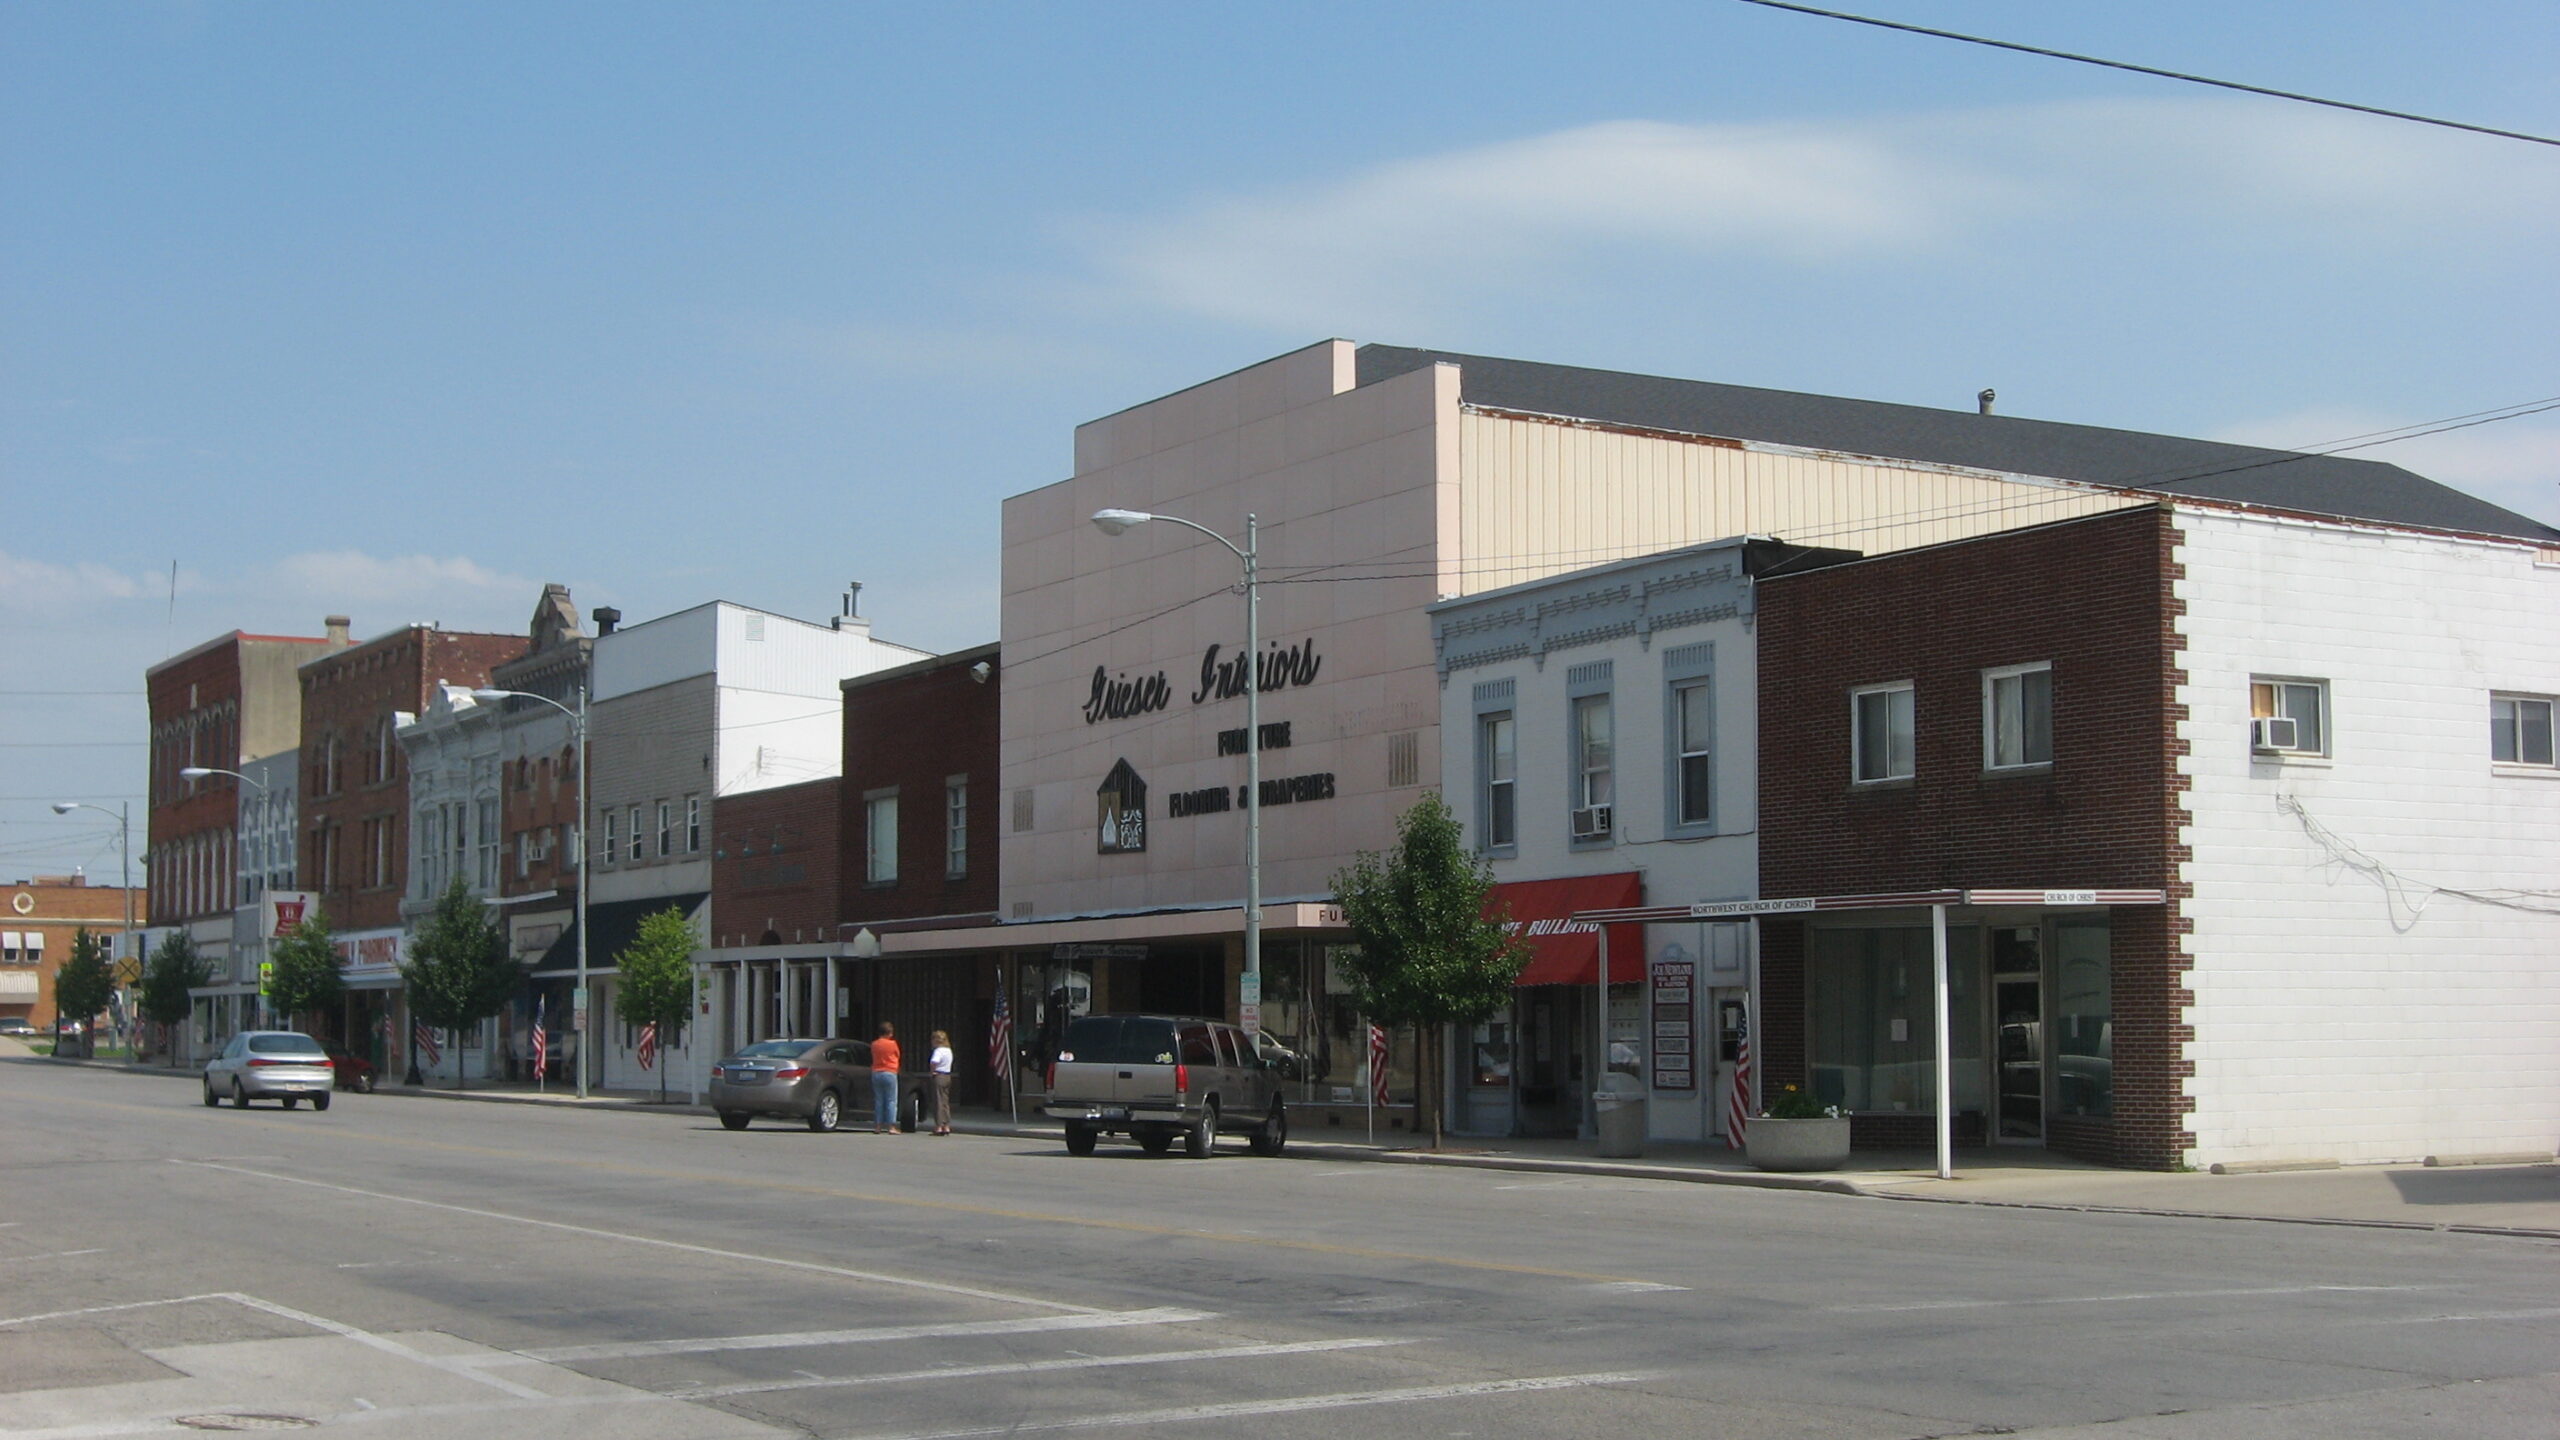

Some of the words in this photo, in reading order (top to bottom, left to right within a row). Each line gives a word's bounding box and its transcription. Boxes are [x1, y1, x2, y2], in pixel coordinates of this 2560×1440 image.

[1082, 665, 1171, 725] Grieser
[1218, 721, 1291, 757] FURNTURE
[1169, 786, 1230, 817] FLOORING
[1238, 784, 1249, 809] &
[1258, 773, 1335, 807] DRAPERIES
[1693, 903, 1737, 914] NORTHWEST
[1739, 901, 1770, 911] CHURCH
[1772, 901, 1782, 909] OF
[1784, 900, 1813, 909] CHRIST
[2047, 893, 2067, 901] CHURCH
[2069, 893, 2075, 901] OF
[2077, 893, 2095, 901] CHRIST
